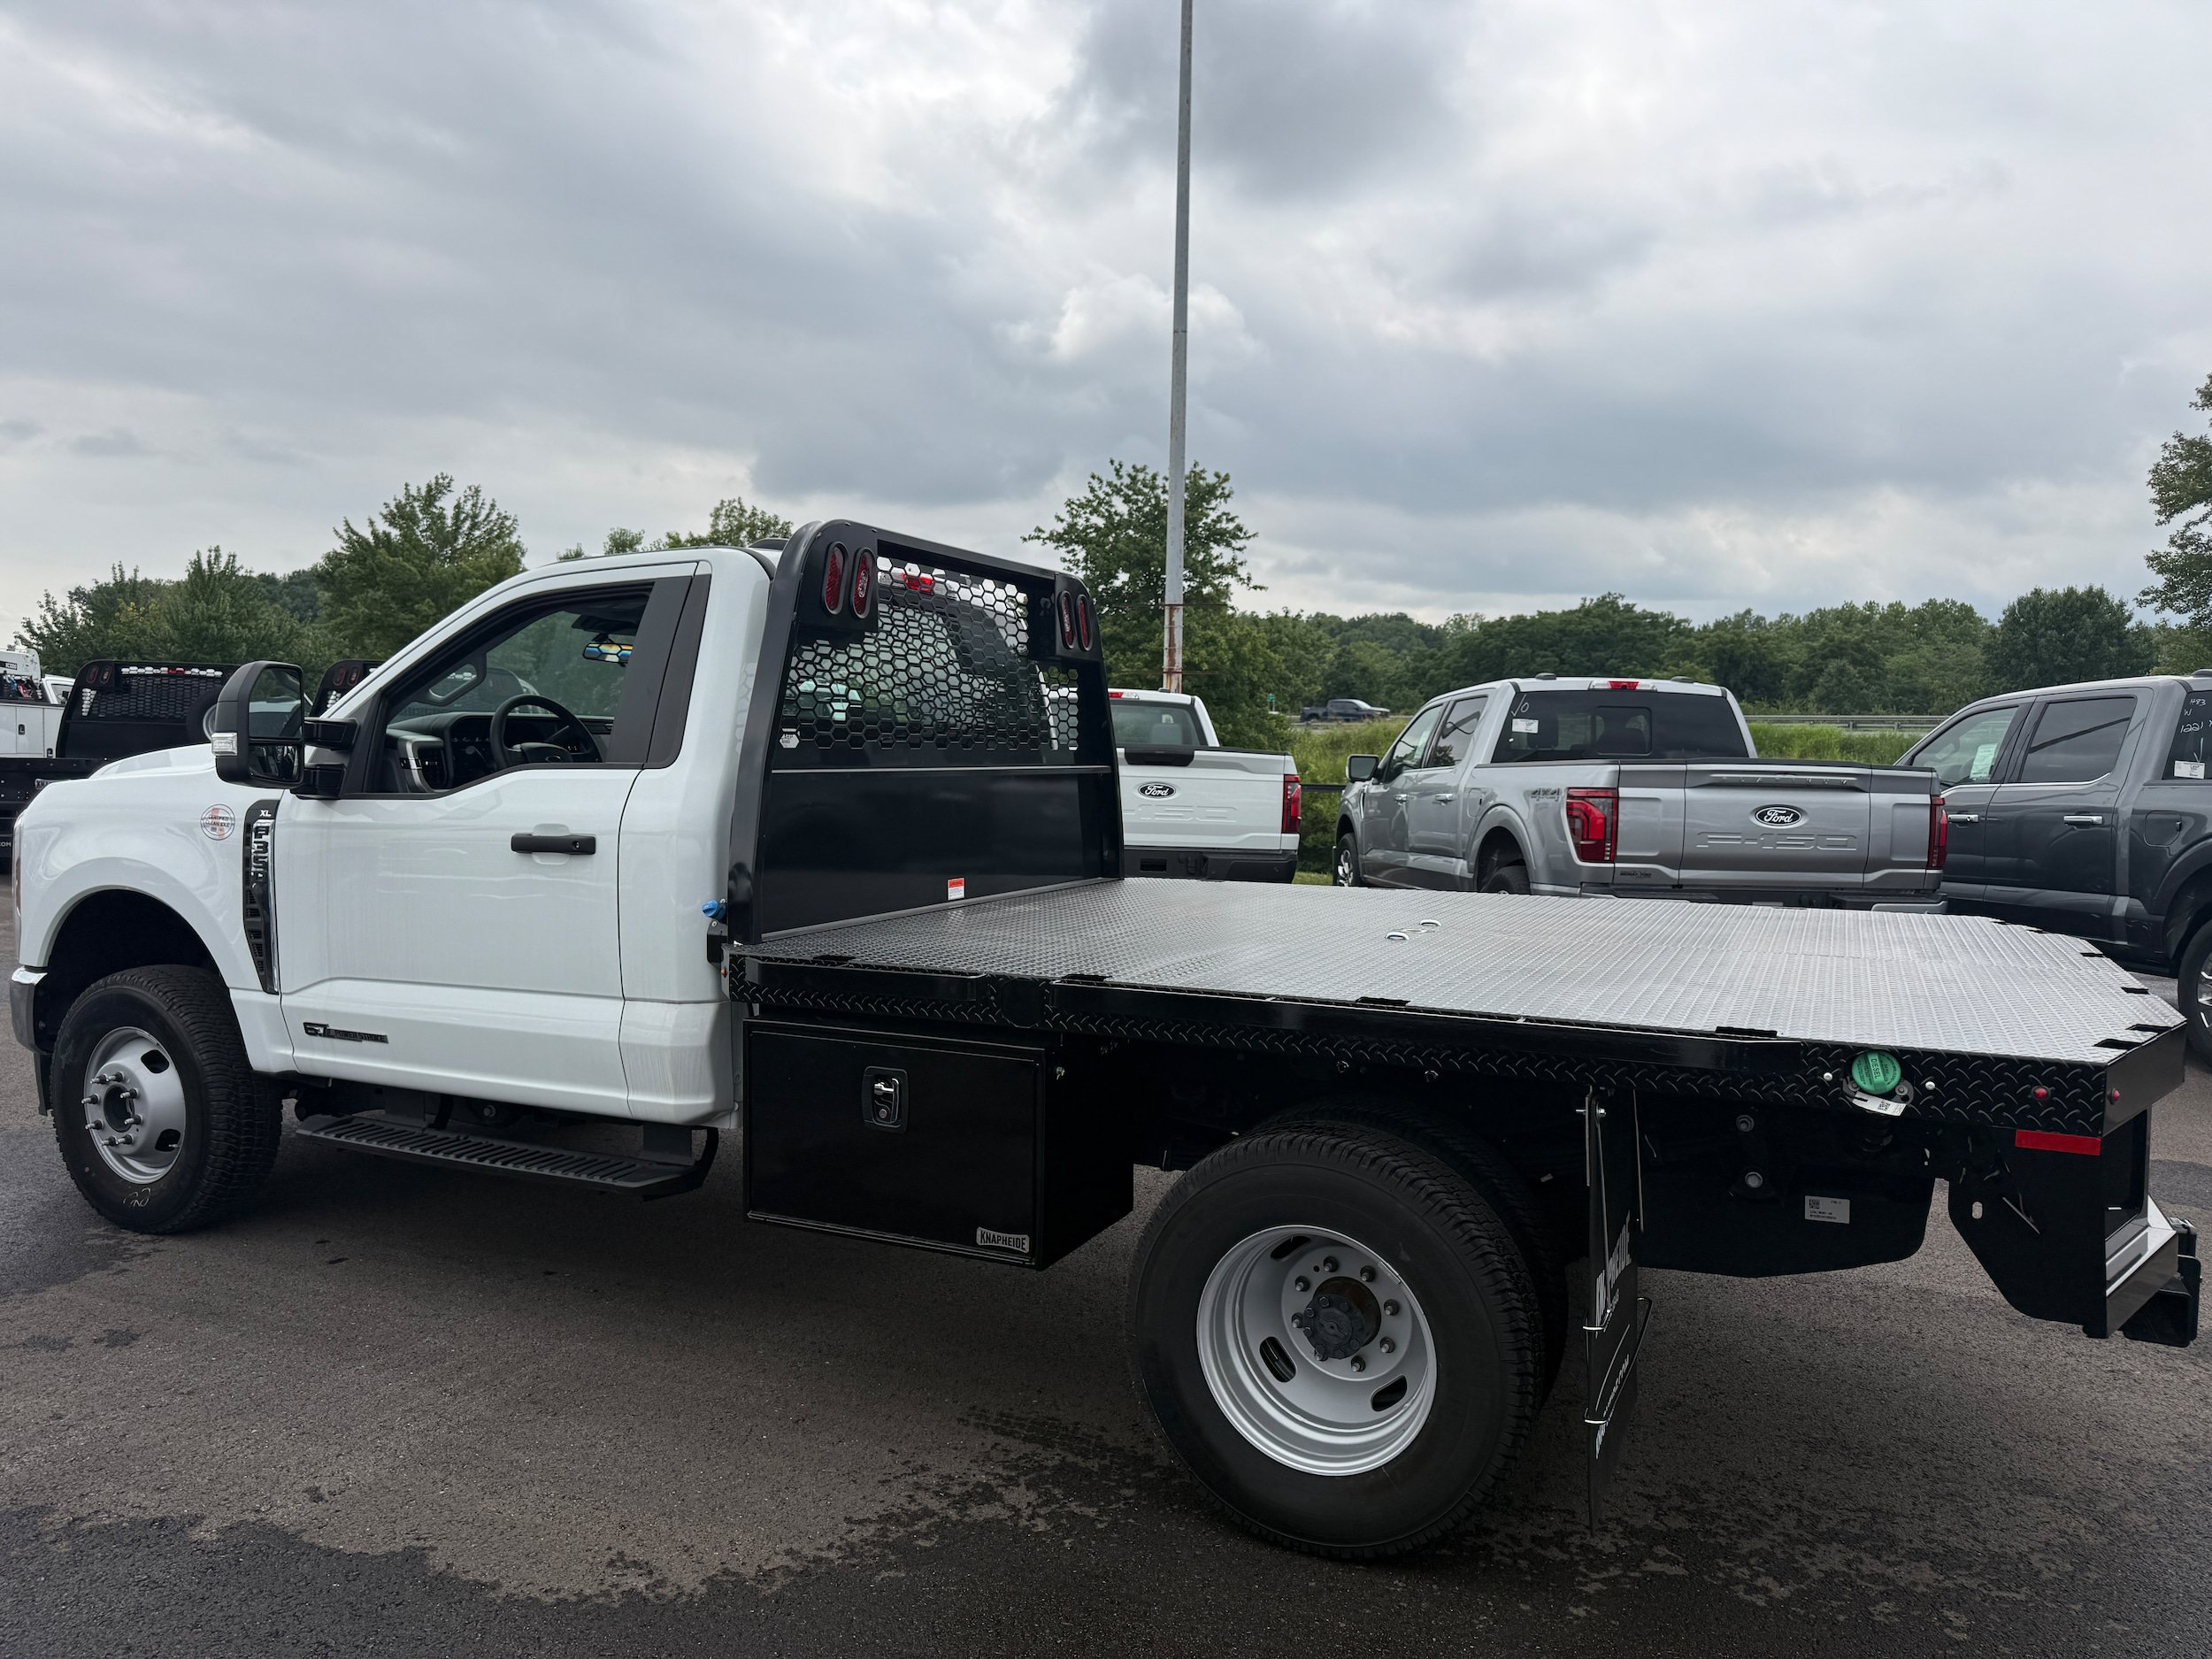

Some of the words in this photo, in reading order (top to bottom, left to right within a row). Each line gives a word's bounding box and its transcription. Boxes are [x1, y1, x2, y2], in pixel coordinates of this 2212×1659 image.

[1763, 809, 1795, 824] Ford
[1696, 832, 1858, 851] F-150
[1870, 1058, 1881, 1079] DIESEL
[979, 1230, 1026, 1250] KNAPHEIDE
